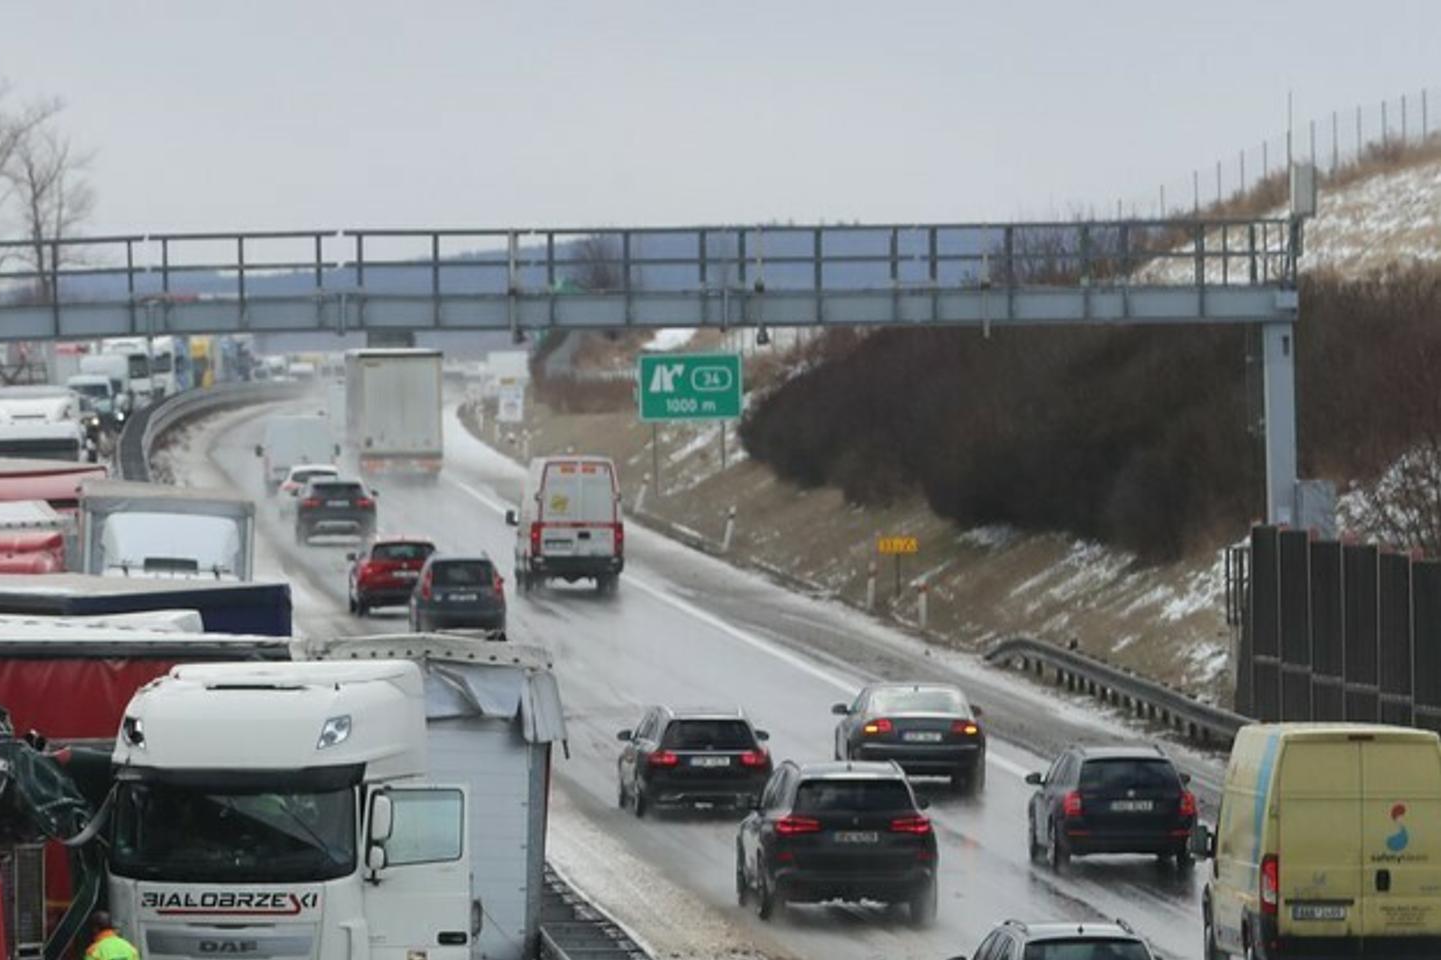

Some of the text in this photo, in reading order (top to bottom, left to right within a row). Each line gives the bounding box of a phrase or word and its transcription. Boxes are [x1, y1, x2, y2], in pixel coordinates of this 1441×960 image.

[666, 398, 716, 413] 1000 m
[199, 940, 258, 953] DAF
